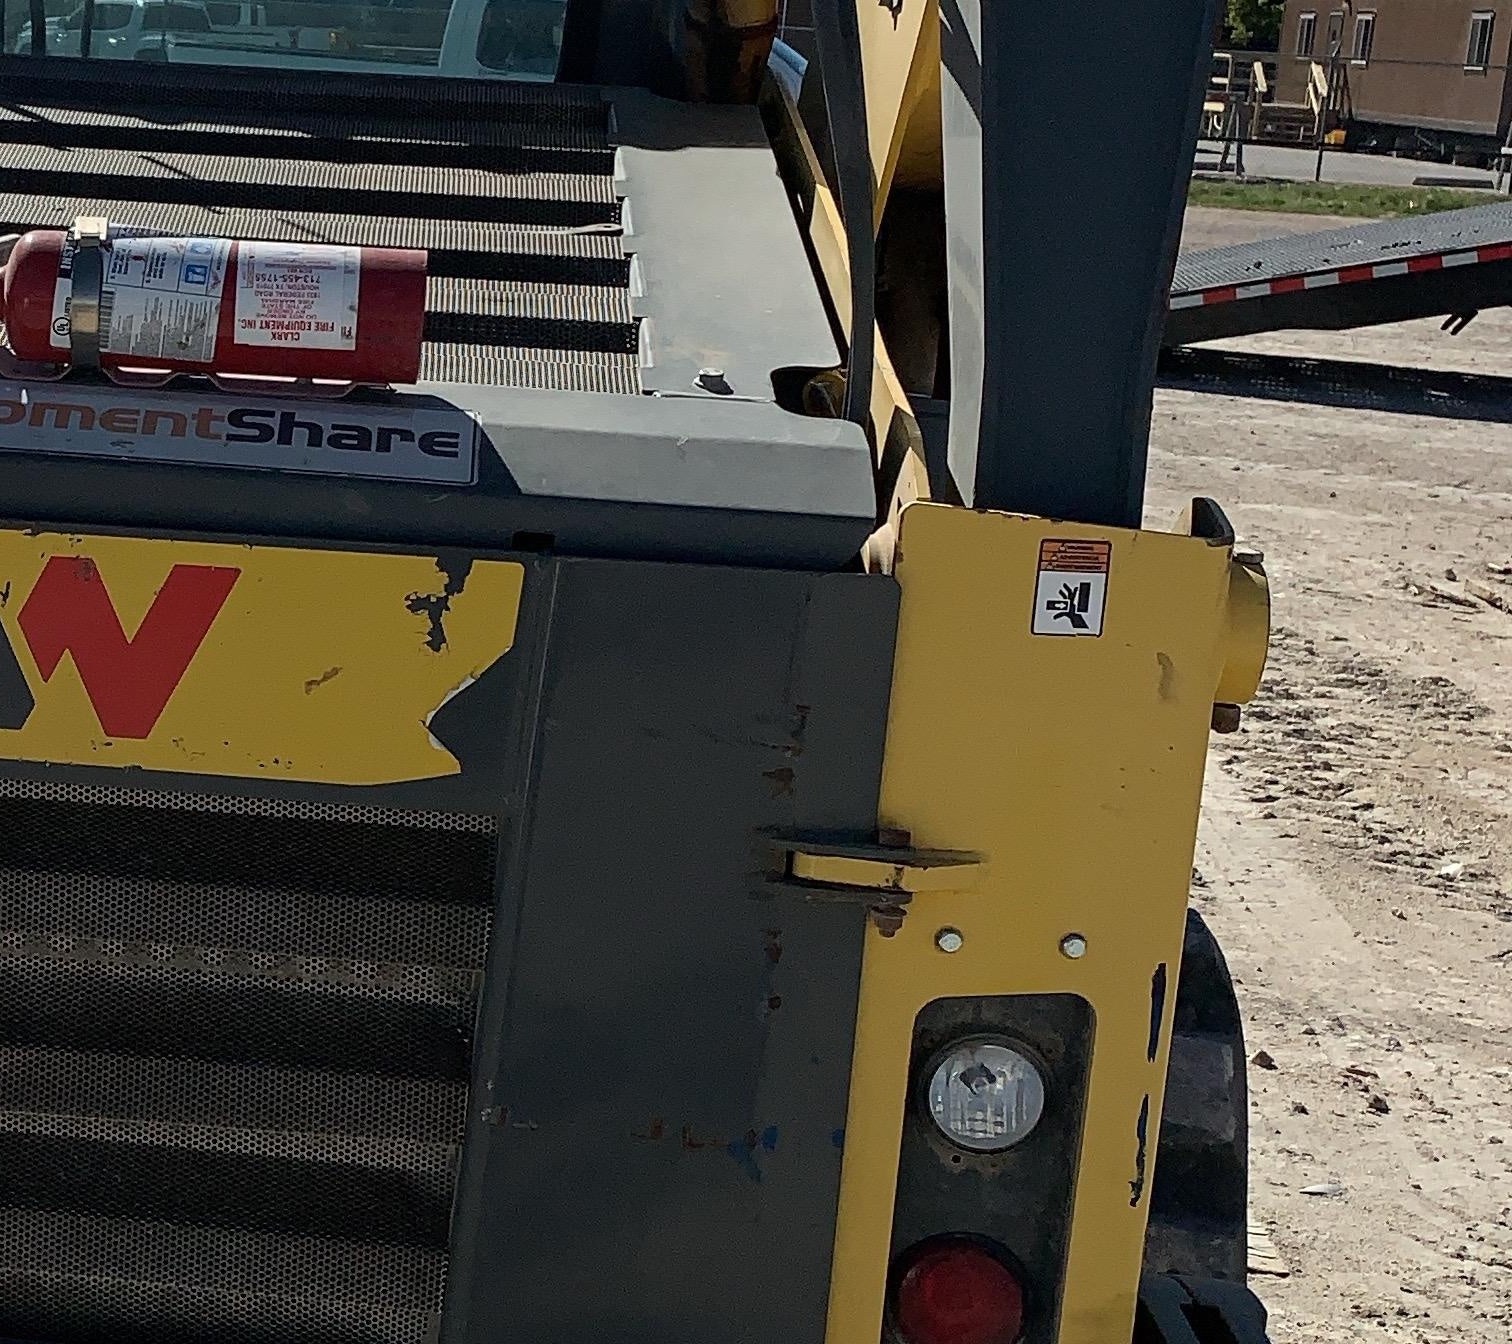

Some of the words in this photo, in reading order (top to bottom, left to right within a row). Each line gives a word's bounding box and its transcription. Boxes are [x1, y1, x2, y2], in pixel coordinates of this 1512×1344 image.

[237, 318, 257, 330] INC.
[259, 319, 312, 331] EQUIPMENT
[314, 321, 335, 332] FIRE
[270, 331, 301, 341] CLARK
